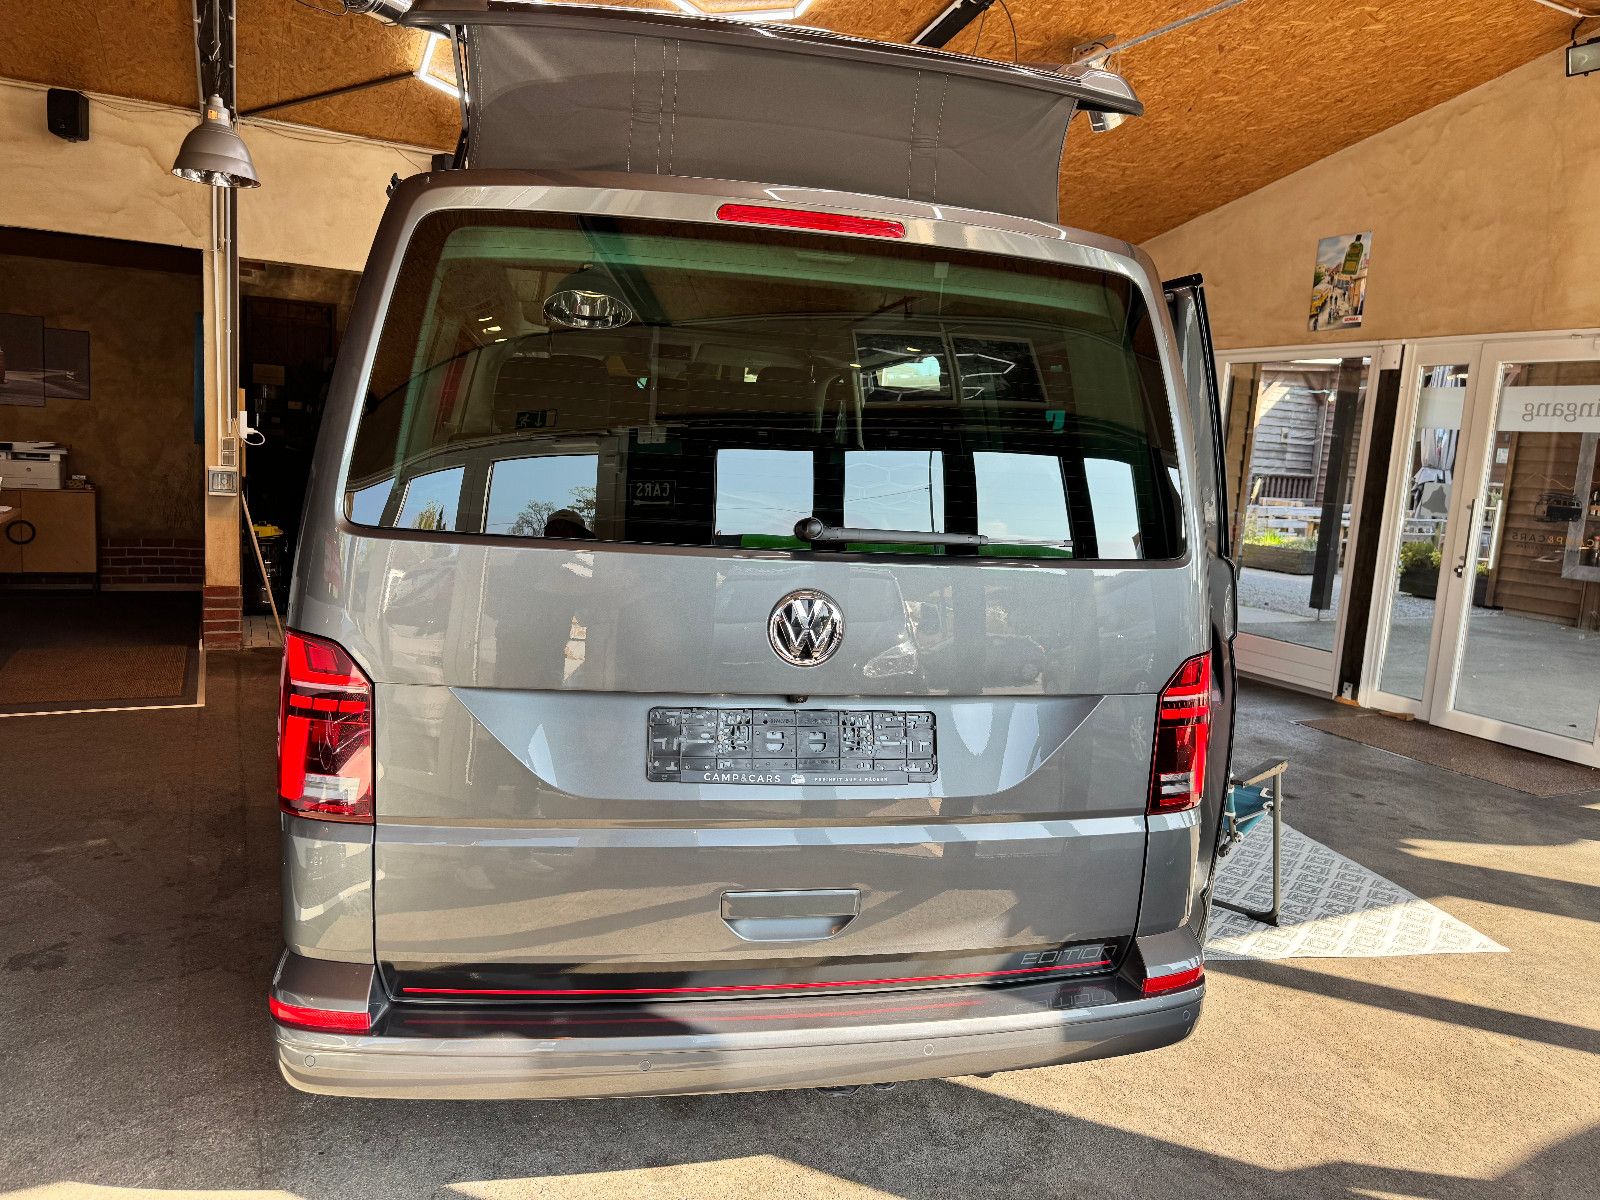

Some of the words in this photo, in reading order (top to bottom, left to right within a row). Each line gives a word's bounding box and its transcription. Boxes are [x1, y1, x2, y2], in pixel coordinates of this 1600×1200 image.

[771, 594, 839, 664] VW
[703, 772, 782, 783] CAMP&CARS
[1020, 943, 1118, 965] EDITION
